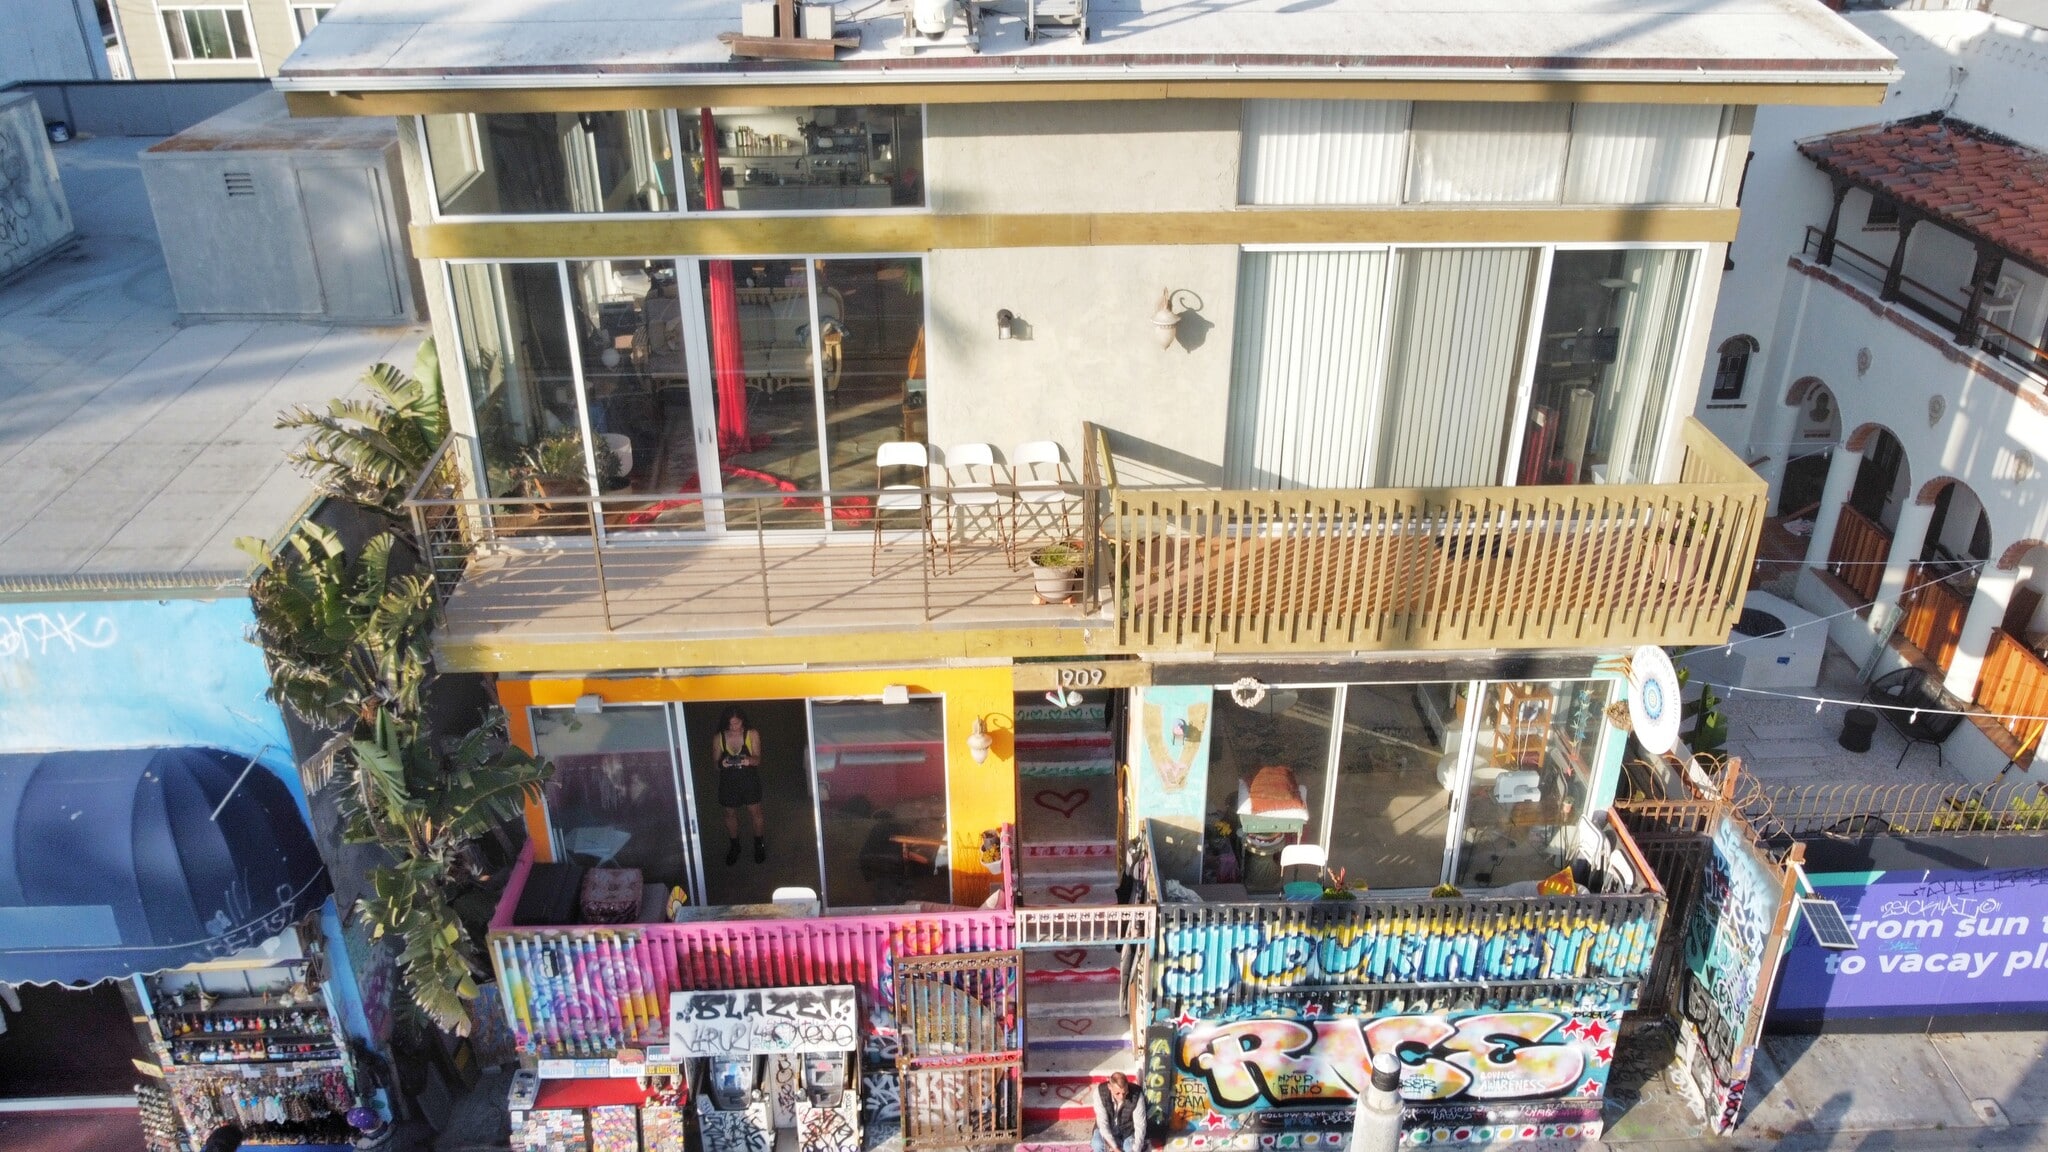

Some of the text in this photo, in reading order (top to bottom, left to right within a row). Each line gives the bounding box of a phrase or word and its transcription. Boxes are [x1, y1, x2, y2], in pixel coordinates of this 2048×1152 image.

[1056, 668, 1103, 687] 1909
[1955, 914, 2030, 938] sun
[1825, 953, 1867, 975] to
[1879, 951, 1999, 979] vacay
[1480, 1079, 1546, 1092] AWARENESS
